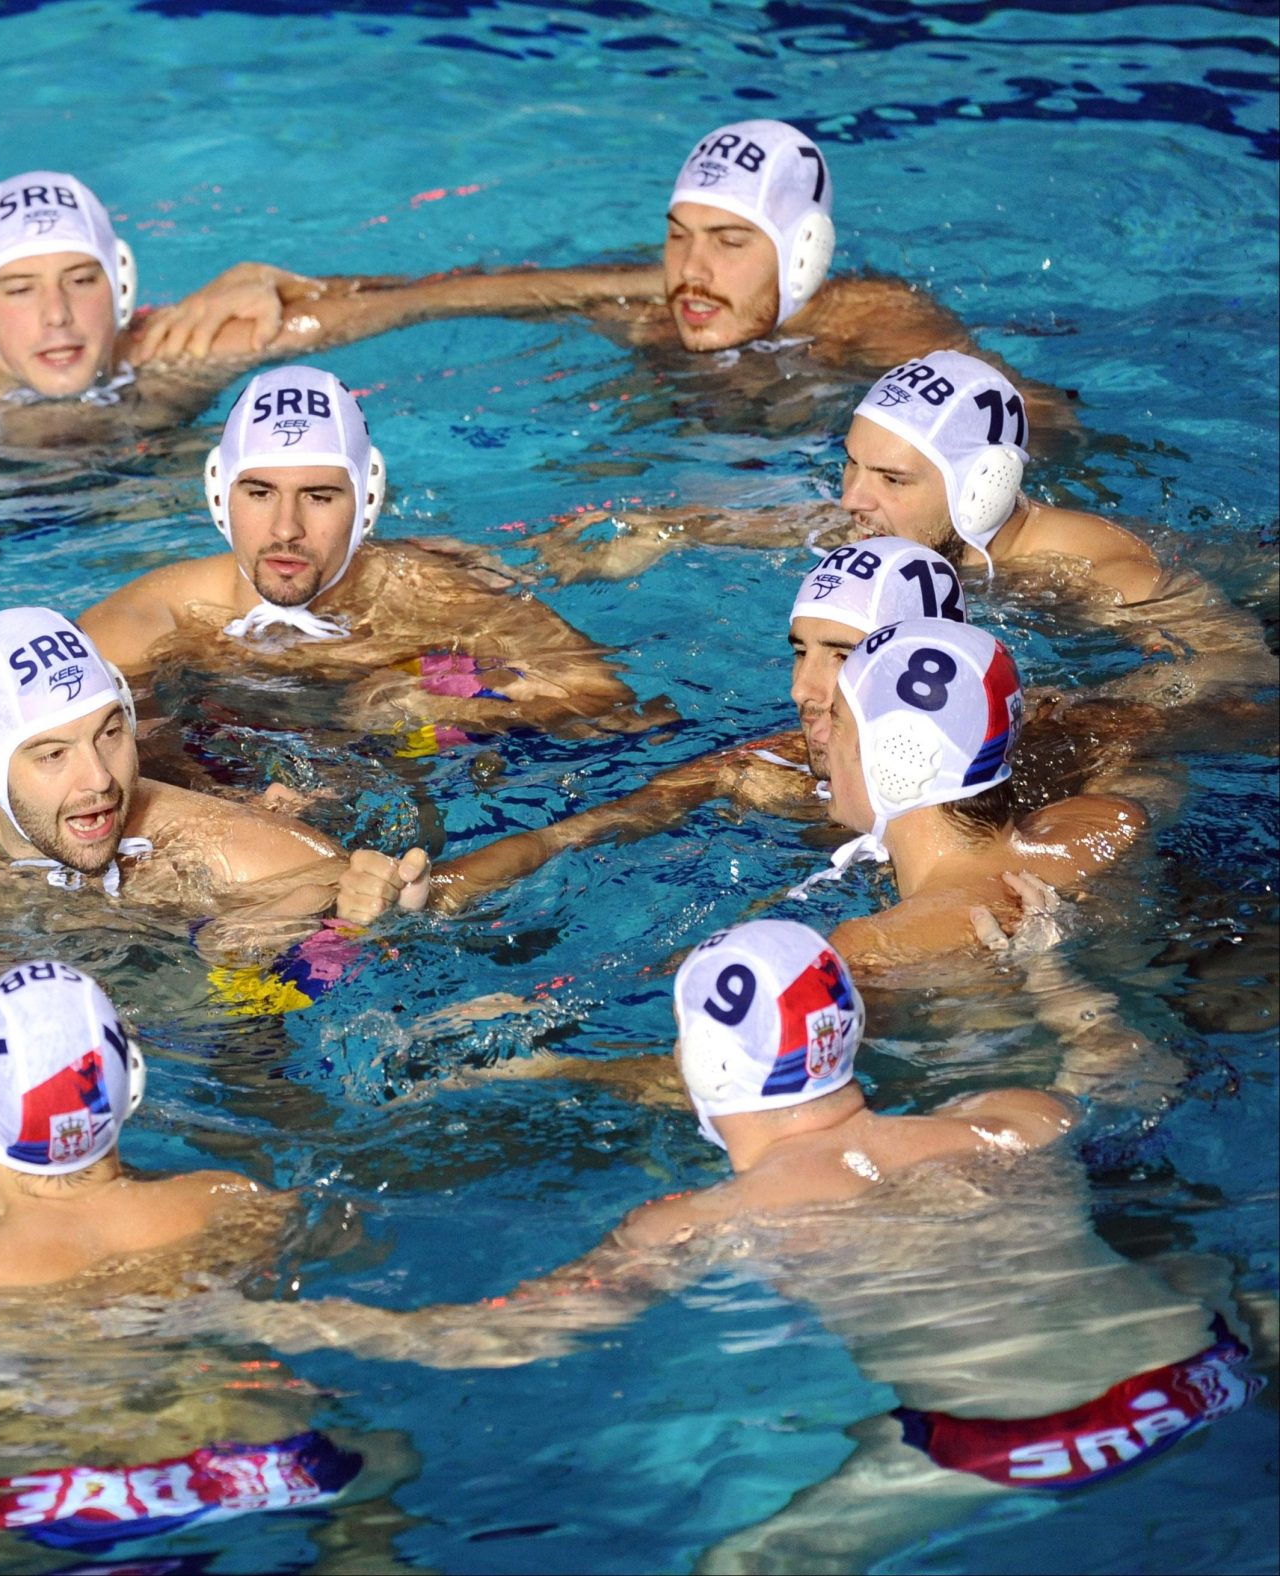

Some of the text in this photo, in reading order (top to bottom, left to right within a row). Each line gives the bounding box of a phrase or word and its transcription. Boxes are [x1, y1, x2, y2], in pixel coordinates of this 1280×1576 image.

[798, 146, 825, 202] 7
[0, 186, 78, 220] SRB
[253, 388, 331, 424] SRB
[884, 383, 913, 402] KEEL
[973, 389, 1024, 446] 11
[273, 419, 311, 430] KEEL
[815, 574, 843, 584] KEEL
[898, 559, 965, 623] 12
[9, 630, 88, 686] SRB
[49, 665, 83, 686] KEEL
[896, 648, 957, 712] 8
[703, 963, 756, 1026] 9
[1008, 1408, 1191, 1478] SRB
